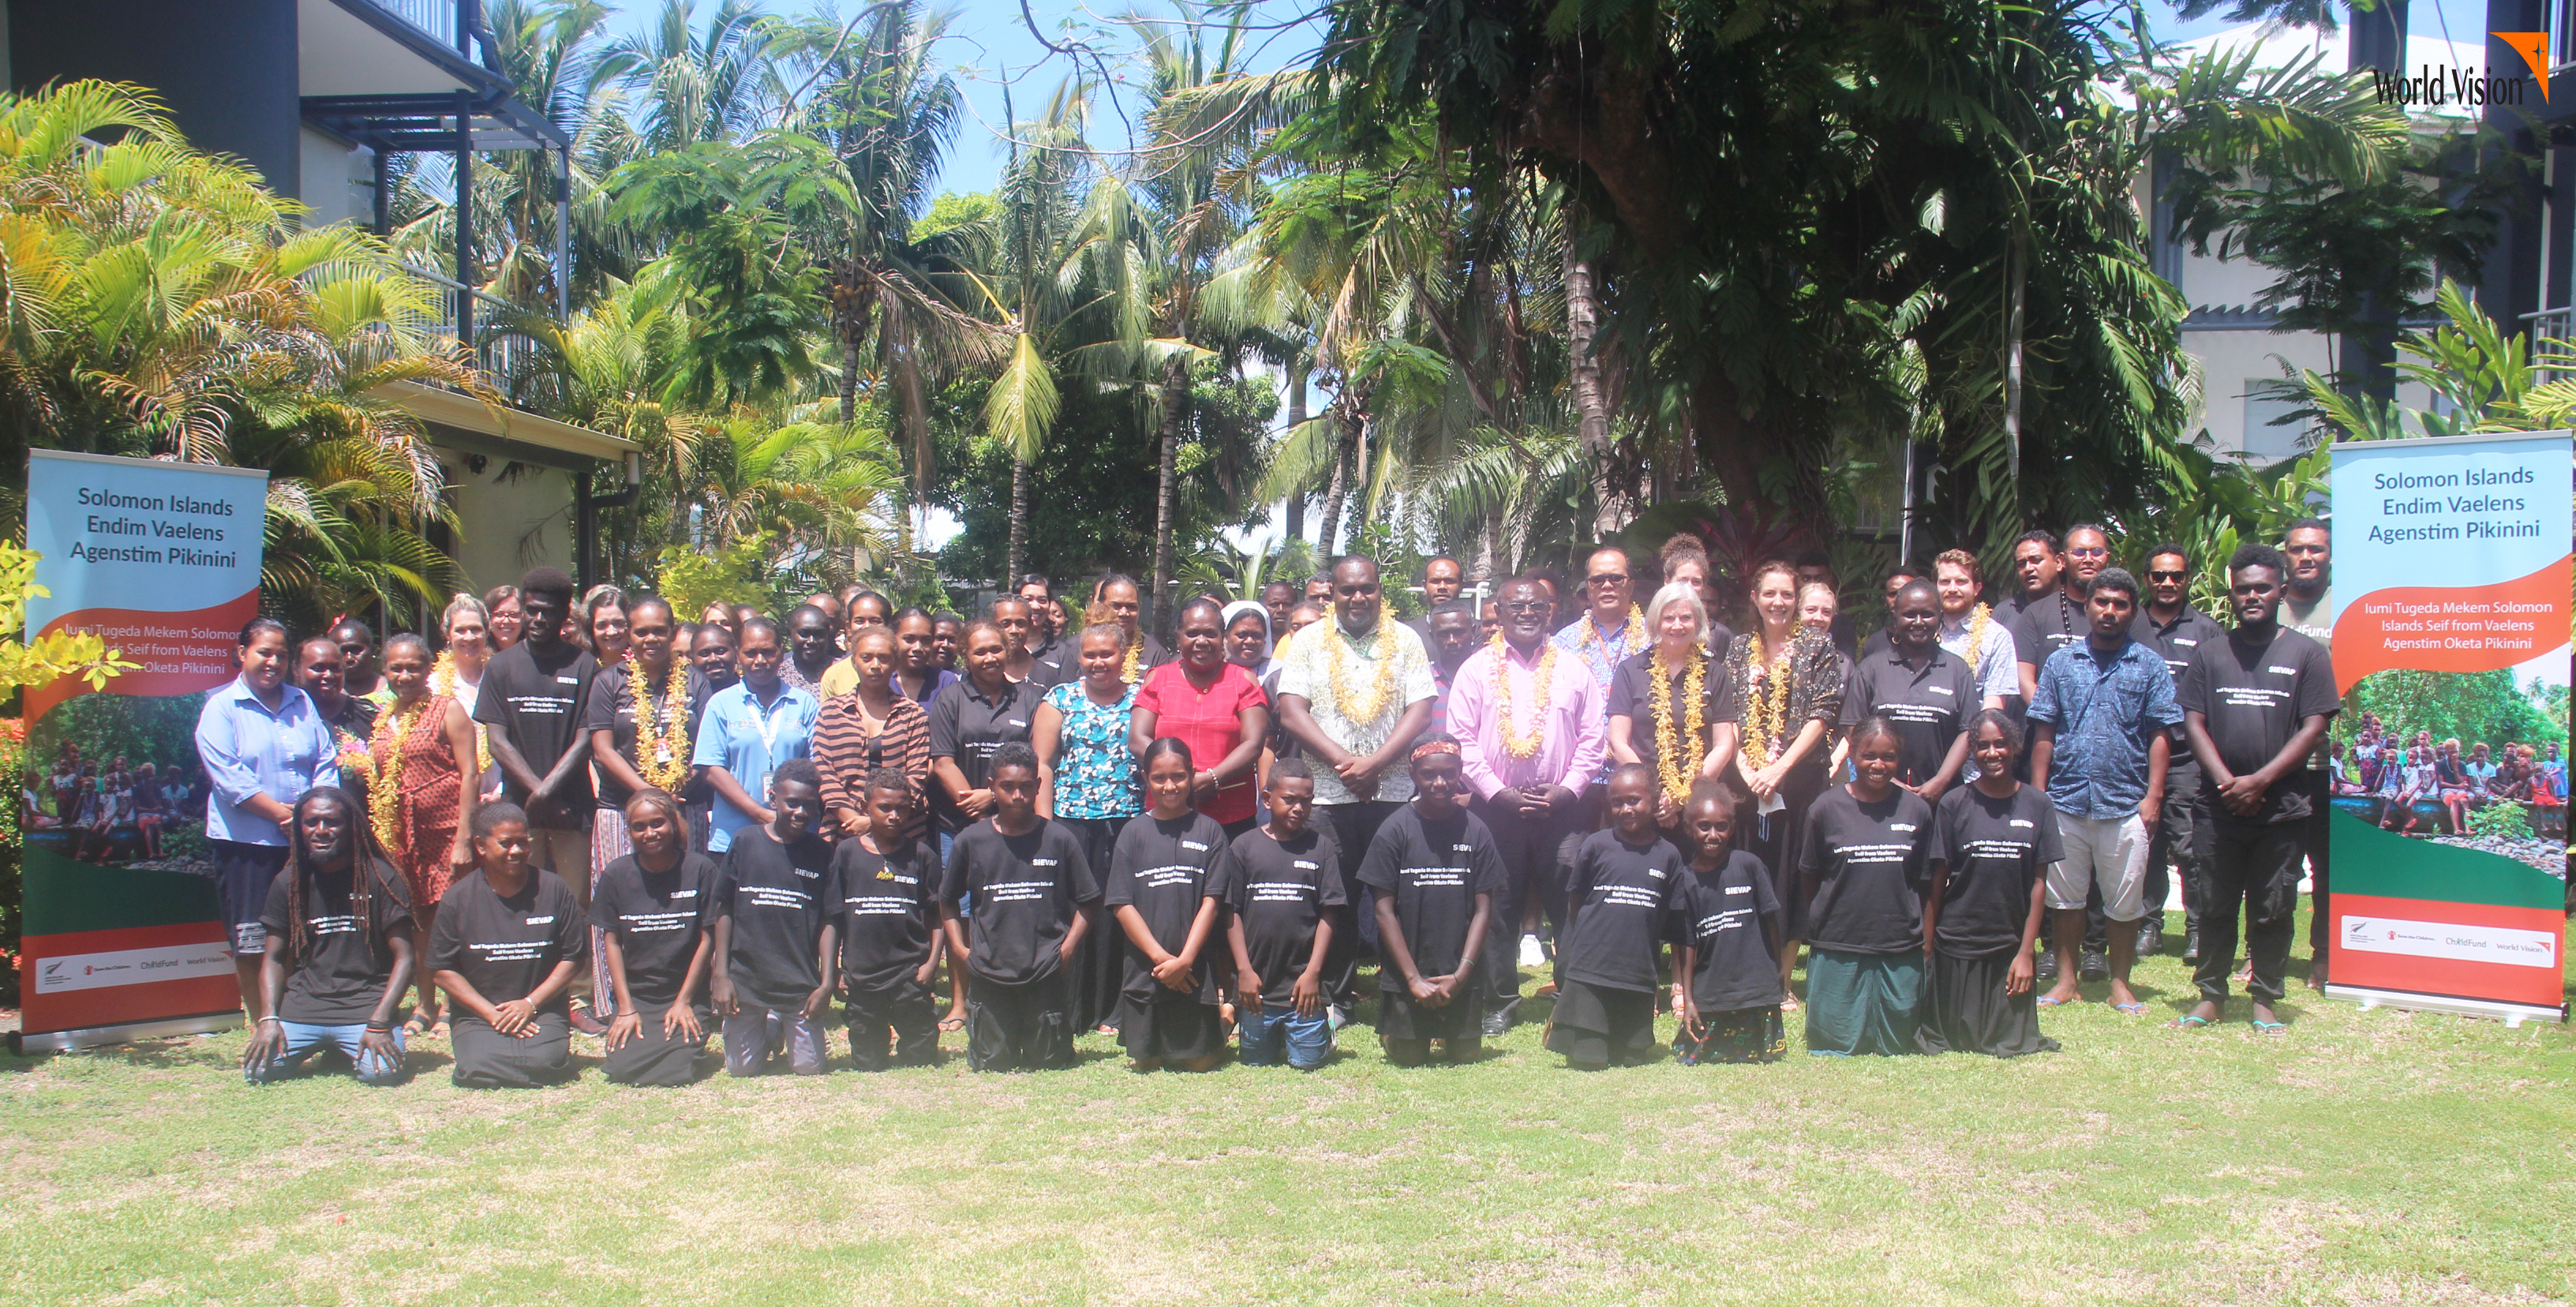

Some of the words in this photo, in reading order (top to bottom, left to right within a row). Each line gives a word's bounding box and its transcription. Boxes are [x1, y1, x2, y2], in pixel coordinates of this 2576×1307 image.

[2375, 472, 2458, 489] Solomon
[2466, 466, 2534, 486] Islands
[78, 488, 163, 511] Solomon
[170, 495, 233, 516] Islands
[2383, 497, 2442, 515] Endim
[2447, 495, 2525, 512] Vaelens
[88, 515, 146, 536] Endim
[152, 520, 223, 541] Vaelens
[2368, 522, 2458, 545] Agenstim
[2466, 519, 2540, 538] Pikinini
[70, 541, 162, 564] Agenstim
[169, 548, 236, 567] Pikinini
[2394, 602, 2439, 616] Tugeda
[2443, 602, 2489, 613] Mekem
[2493, 601, 2552, 613] Solomon
[95, 624, 140, 639] Tugeda
[145, 626, 188, 639] Mekem
[2382, 620, 2423, 631] Islands
[2426, 620, 2449, 631] Seif
[2452, 620, 2481, 631] from
[2484, 619, 2534, 631] Vaelens
[127, 644, 148, 654] Seif
[152, 644, 179, 655] from
[182, 646, 227, 657] Vaelens
[2383, 638, 2441, 651] Agenstim
[2444, 638, 2481, 649] Oketa
[2485, 637, 2532, 649] Pikinini
[144, 662, 178, 673] Oketa
[182, 662, 225, 674] Pikinini
[2268, 666, 2296, 675] SIEVAP
[1929, 686, 1953, 695] SIEVAP
[795, 868, 818, 879] SIEVAP
[1725, 886, 1751, 895] SIEVAP
[526, 916, 554, 925] SIEVAP
